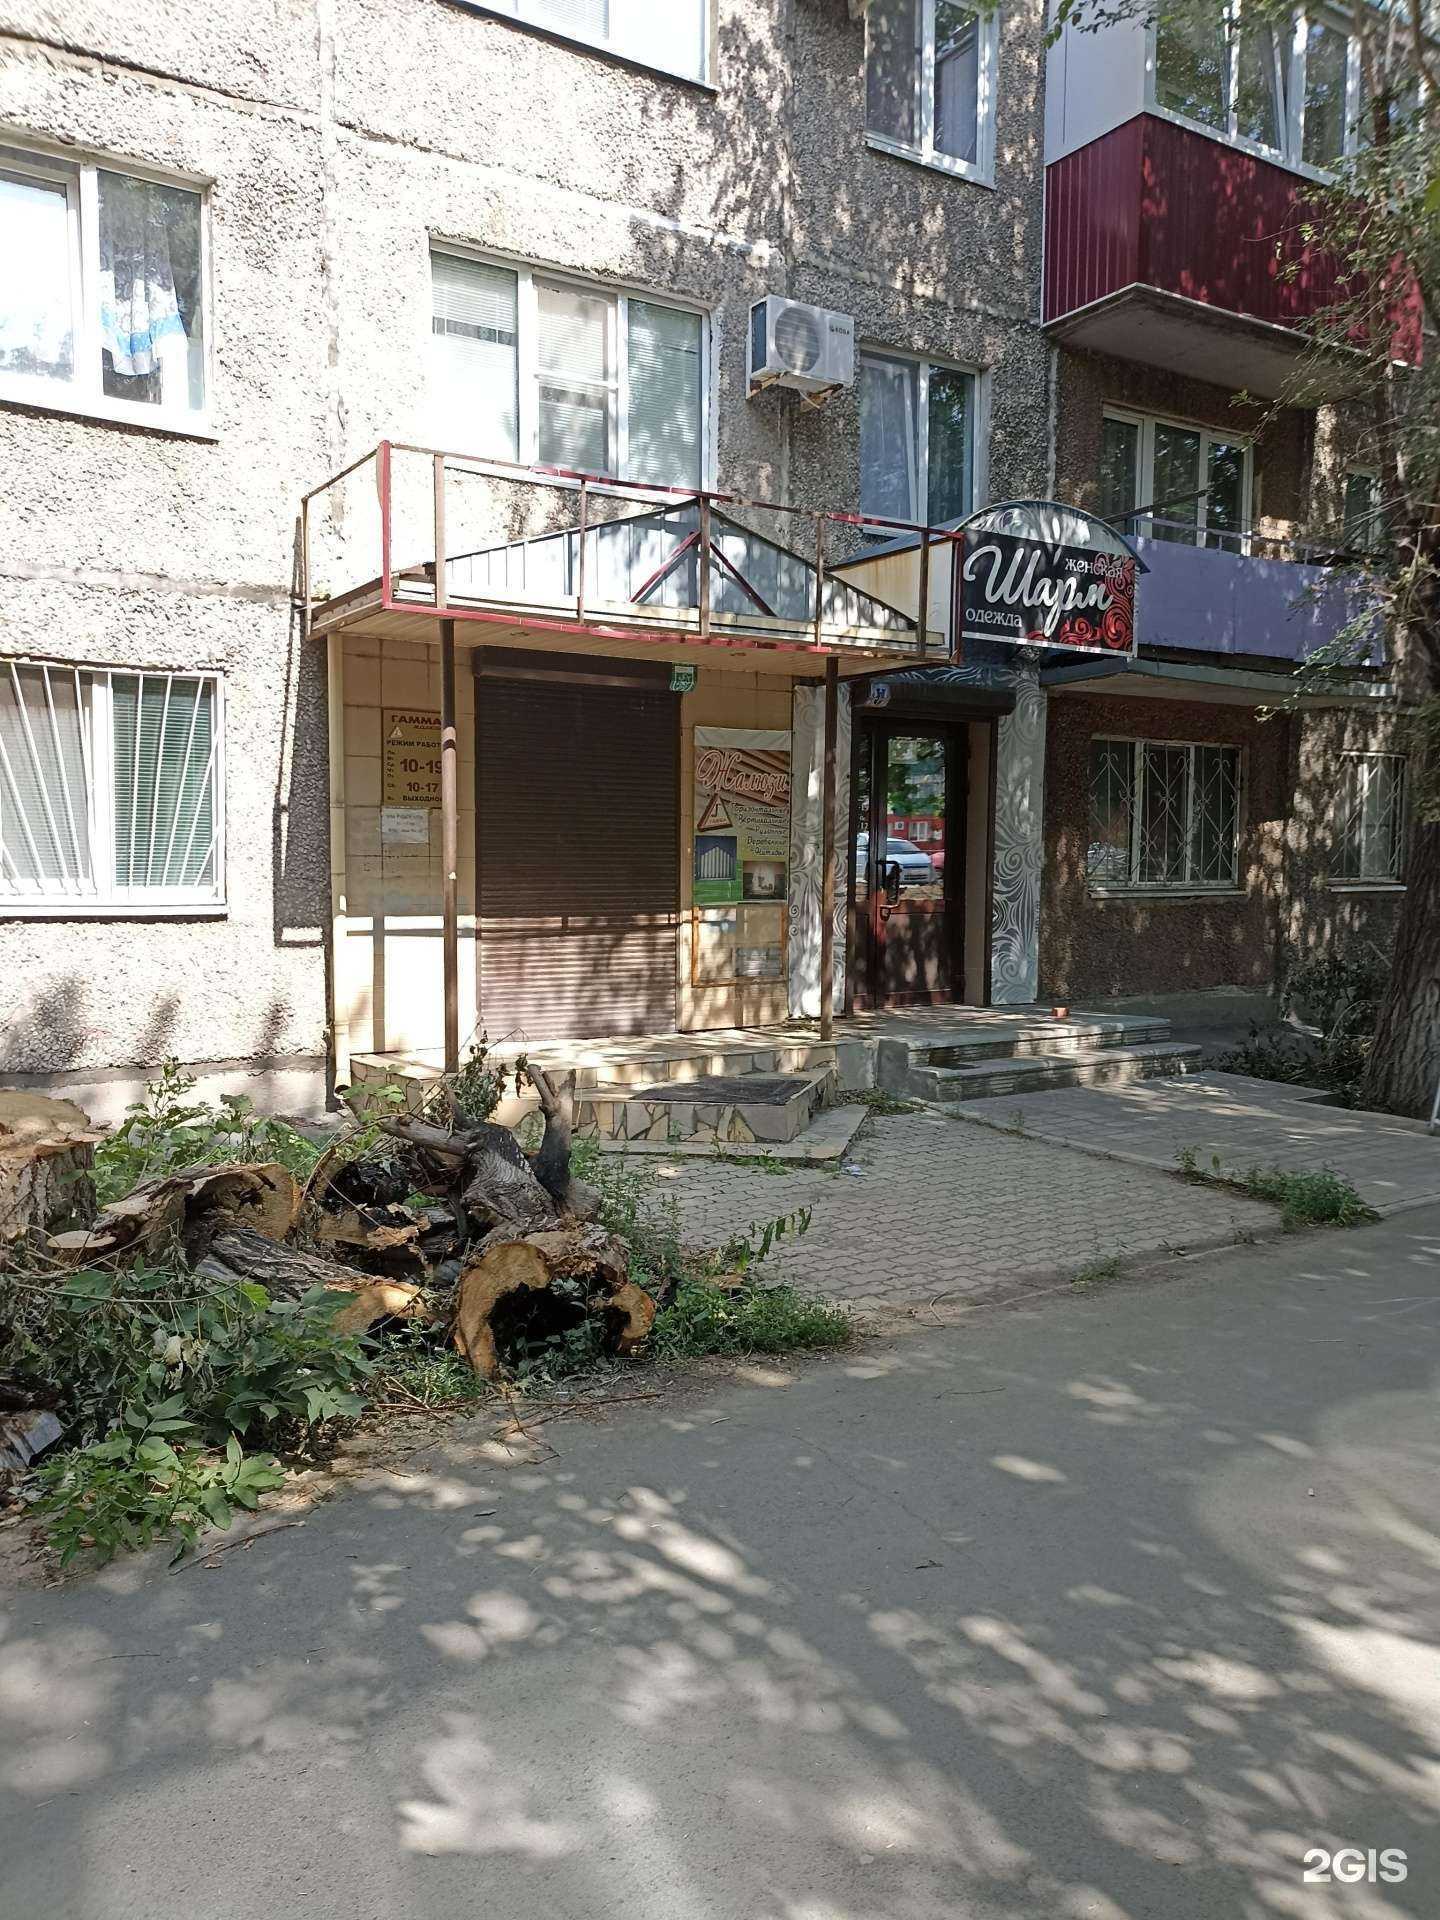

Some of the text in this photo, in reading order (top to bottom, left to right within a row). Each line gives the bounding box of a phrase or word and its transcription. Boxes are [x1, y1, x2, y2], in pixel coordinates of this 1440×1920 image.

[1065, 558, 1123, 579] женская
[963, 545, 1114, 637] Шарм
[965, 608, 1023, 628] одежда
[391, 714, 441, 725] ГАММА
[400, 758, 442, 774] 10-19
[697, 750, 787, 800] Жалюзи
[406, 782, 439, 792] 10-17
